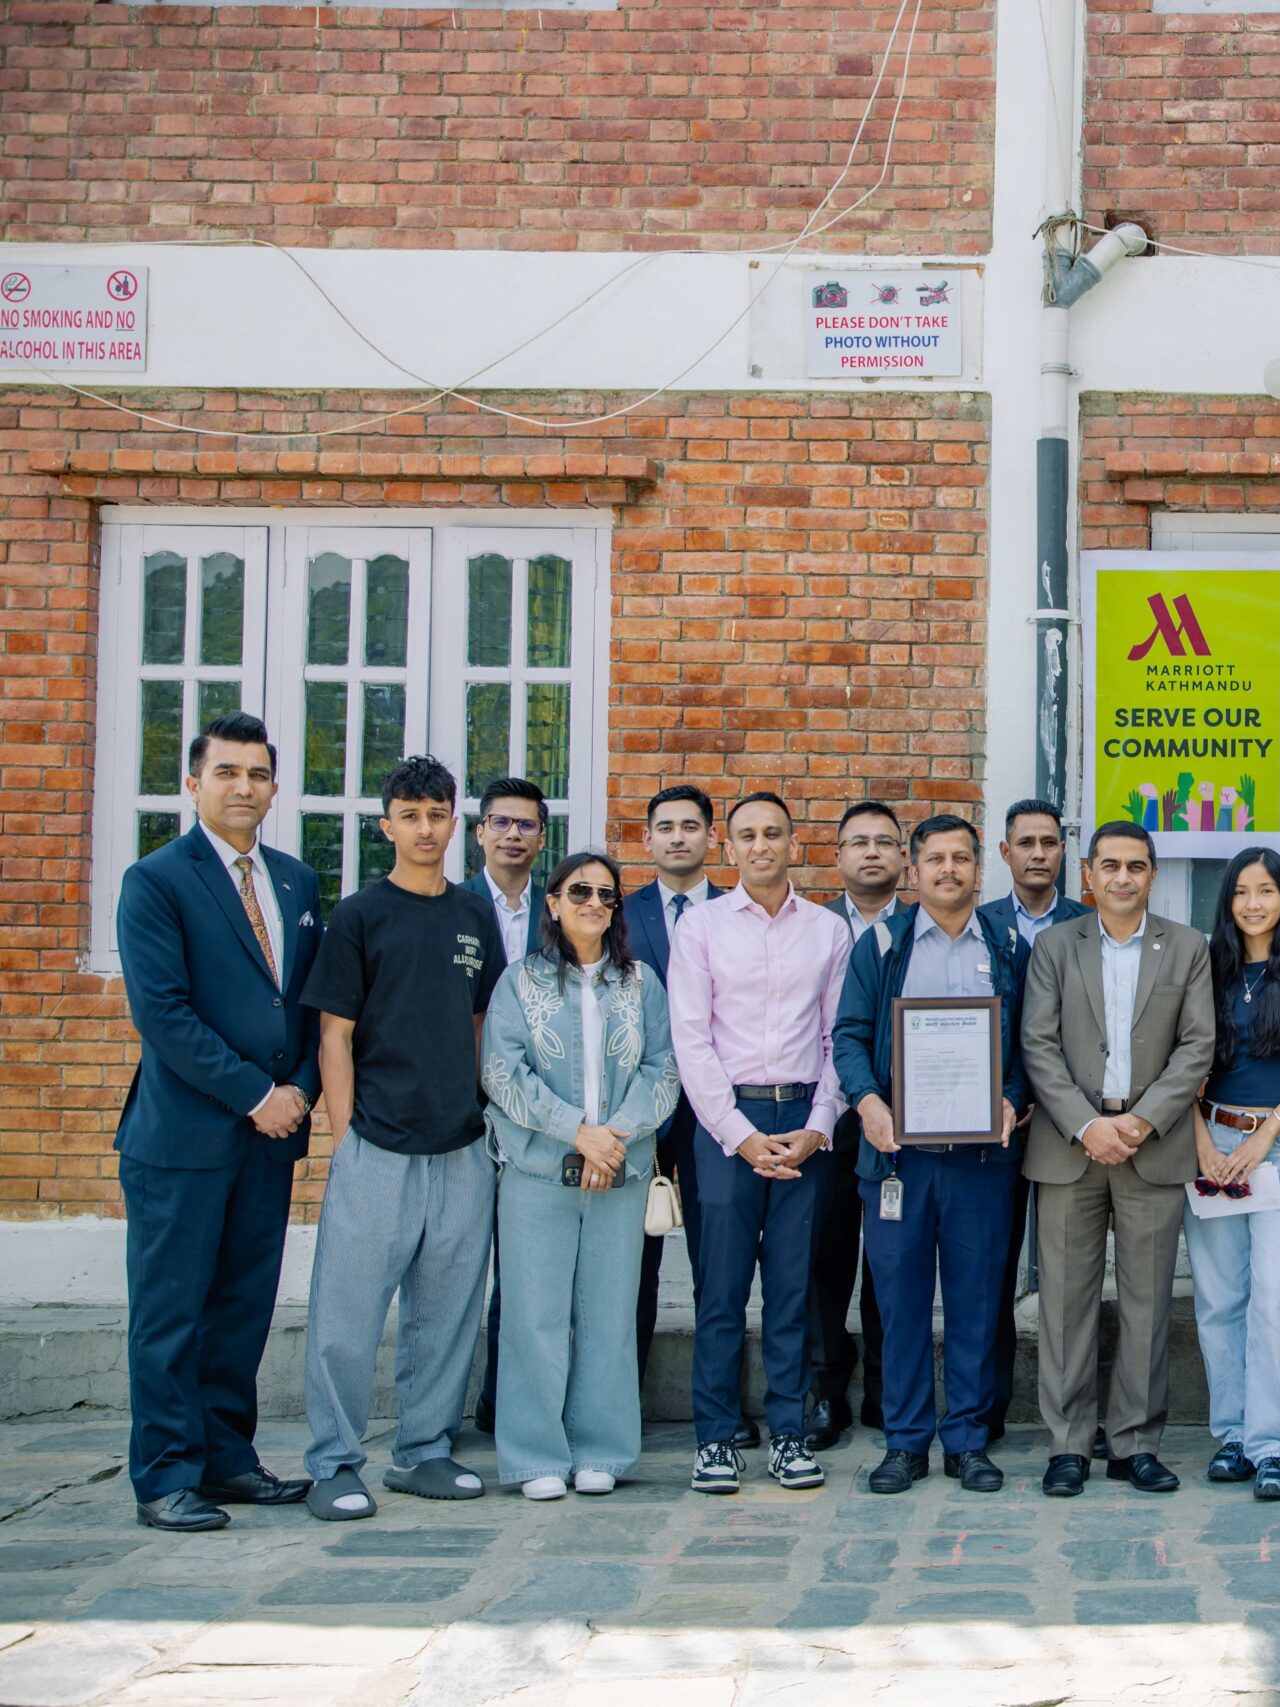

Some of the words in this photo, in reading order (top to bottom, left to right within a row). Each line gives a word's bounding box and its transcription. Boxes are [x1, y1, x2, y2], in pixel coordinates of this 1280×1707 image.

[1, 309, 20, 328] NO
[23, 309, 82, 328] SMOKING
[86, 310, 113, 329] AND
[116, 311, 136, 329] NO
[815, 316, 866, 329] PLEASE
[869, 316, 911, 329] DON'T
[915, 315, 949, 328] TAKE
[825, 335, 873, 349] PHOTO
[875, 335, 940, 348] WITHOUT
[0, 340, 59, 359] ALCOHOL
[62, 341, 75, 359] IN
[78, 342, 105, 360] THIS
[109, 342, 142, 360] AREA
[841, 355, 925, 368] PERMISSION
[1146, 664, 1236, 676] MARRIOTT
[1146, 680, 1252, 691] KATHMANDU
[1114, 708, 1196, 728] SERVE
[1203, 708, 1262, 728] OUR
[1103, 738, 1273, 758] COMMUNITY
